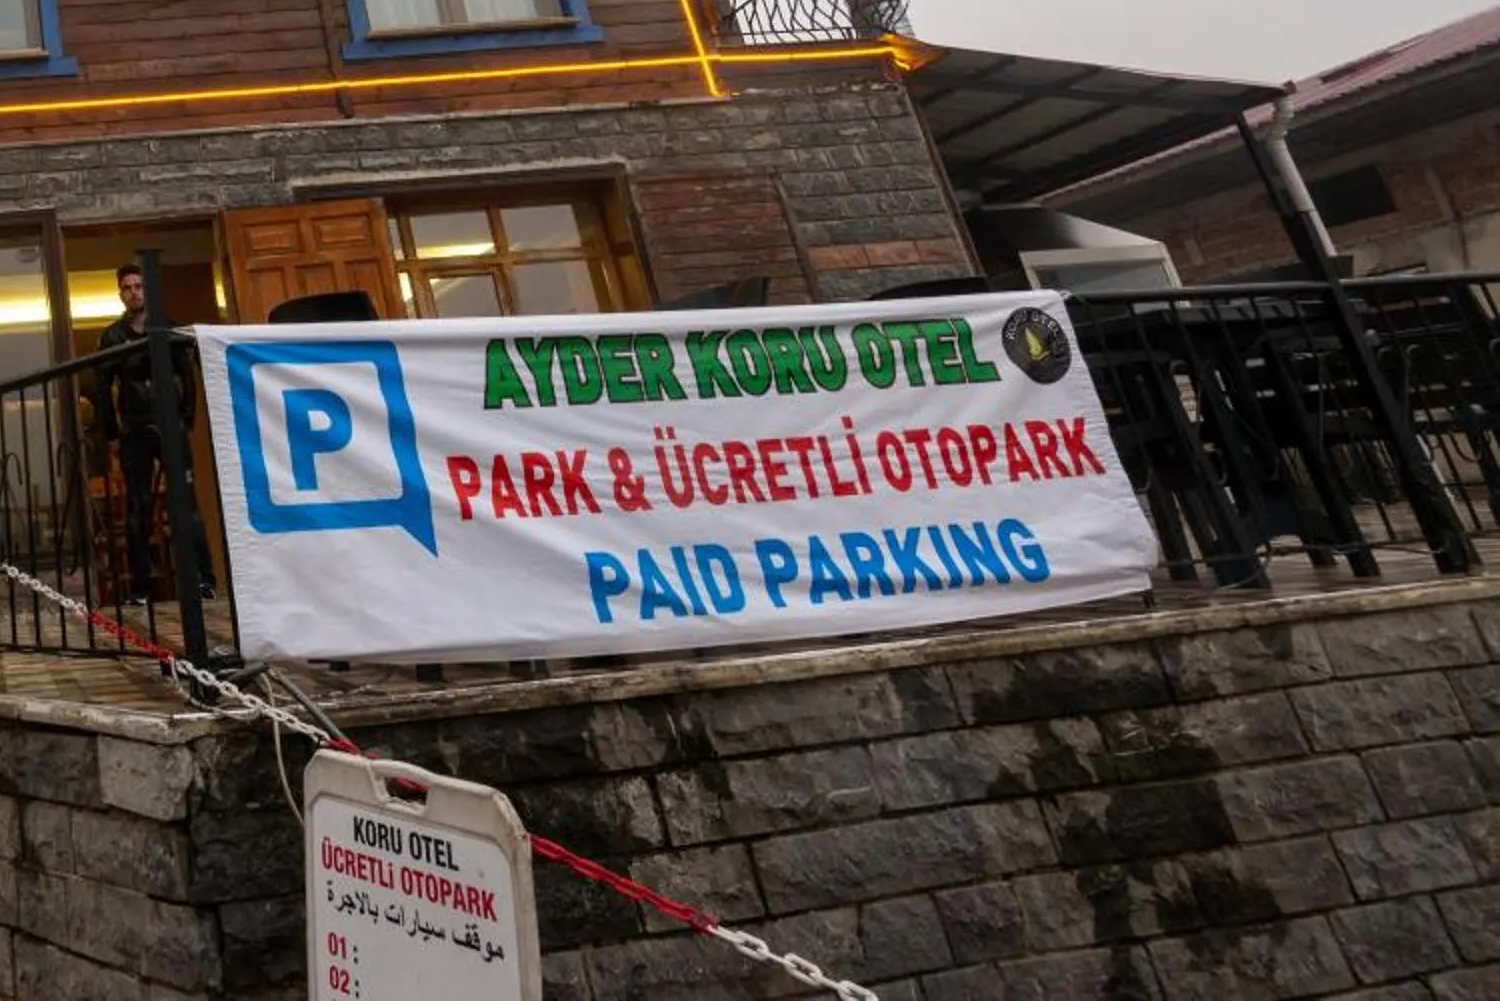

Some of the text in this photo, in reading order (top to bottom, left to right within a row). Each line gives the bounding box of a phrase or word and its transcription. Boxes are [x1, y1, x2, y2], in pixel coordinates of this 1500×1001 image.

[483, 316, 1002, 410] AYDER KORU OTEL
[282, 388, 353, 492] P
[446, 416, 1106, 521] PARK & ÜCRETLİ OTOPARK
[585, 518, 1051, 624] PAID PARKING
[353, 815, 460, 872] KORU OTEL
[384, 904, 446, 942] سيارات
[400, 867, 498, 922] OTOPARK
[451, 923, 505, 964] موقف
